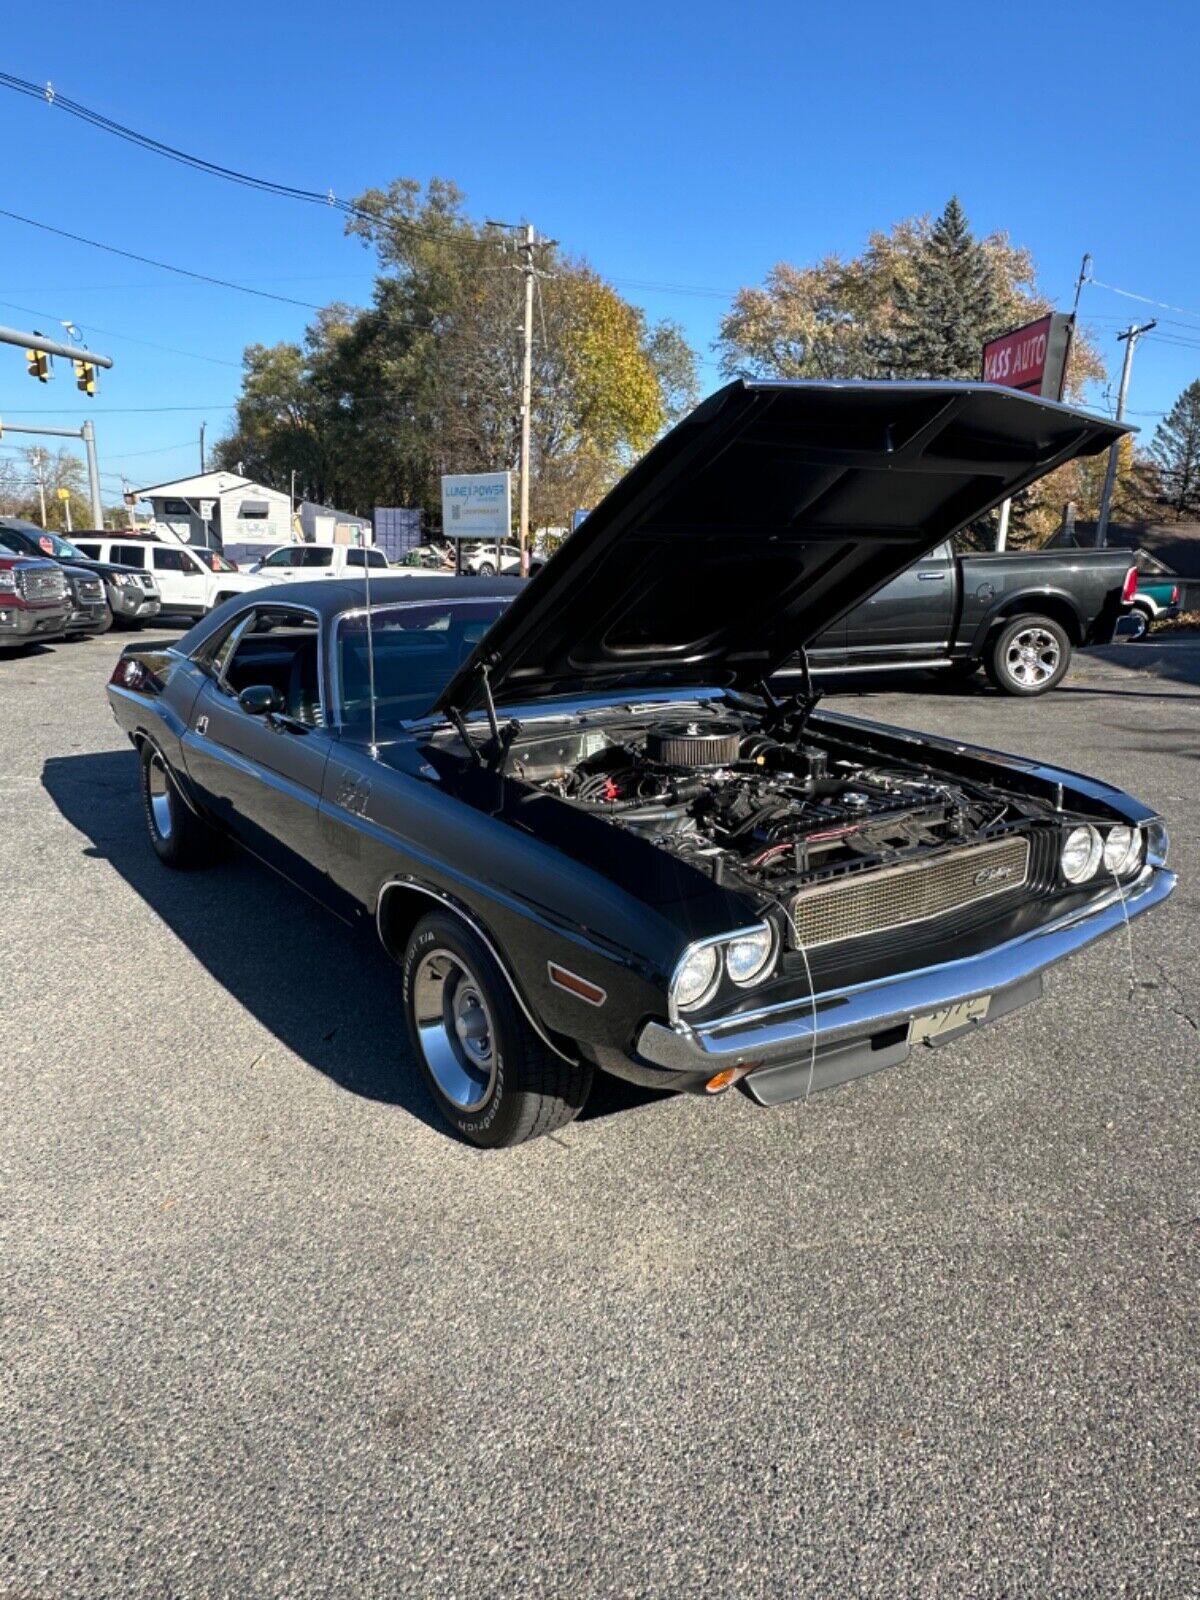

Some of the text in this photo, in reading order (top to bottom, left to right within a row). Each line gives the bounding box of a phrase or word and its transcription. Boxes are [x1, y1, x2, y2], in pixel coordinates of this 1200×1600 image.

[1012, 334, 1046, 374] AUTO
[473, 485, 504, 496] POWER
[418, 931, 435, 945] T/A
